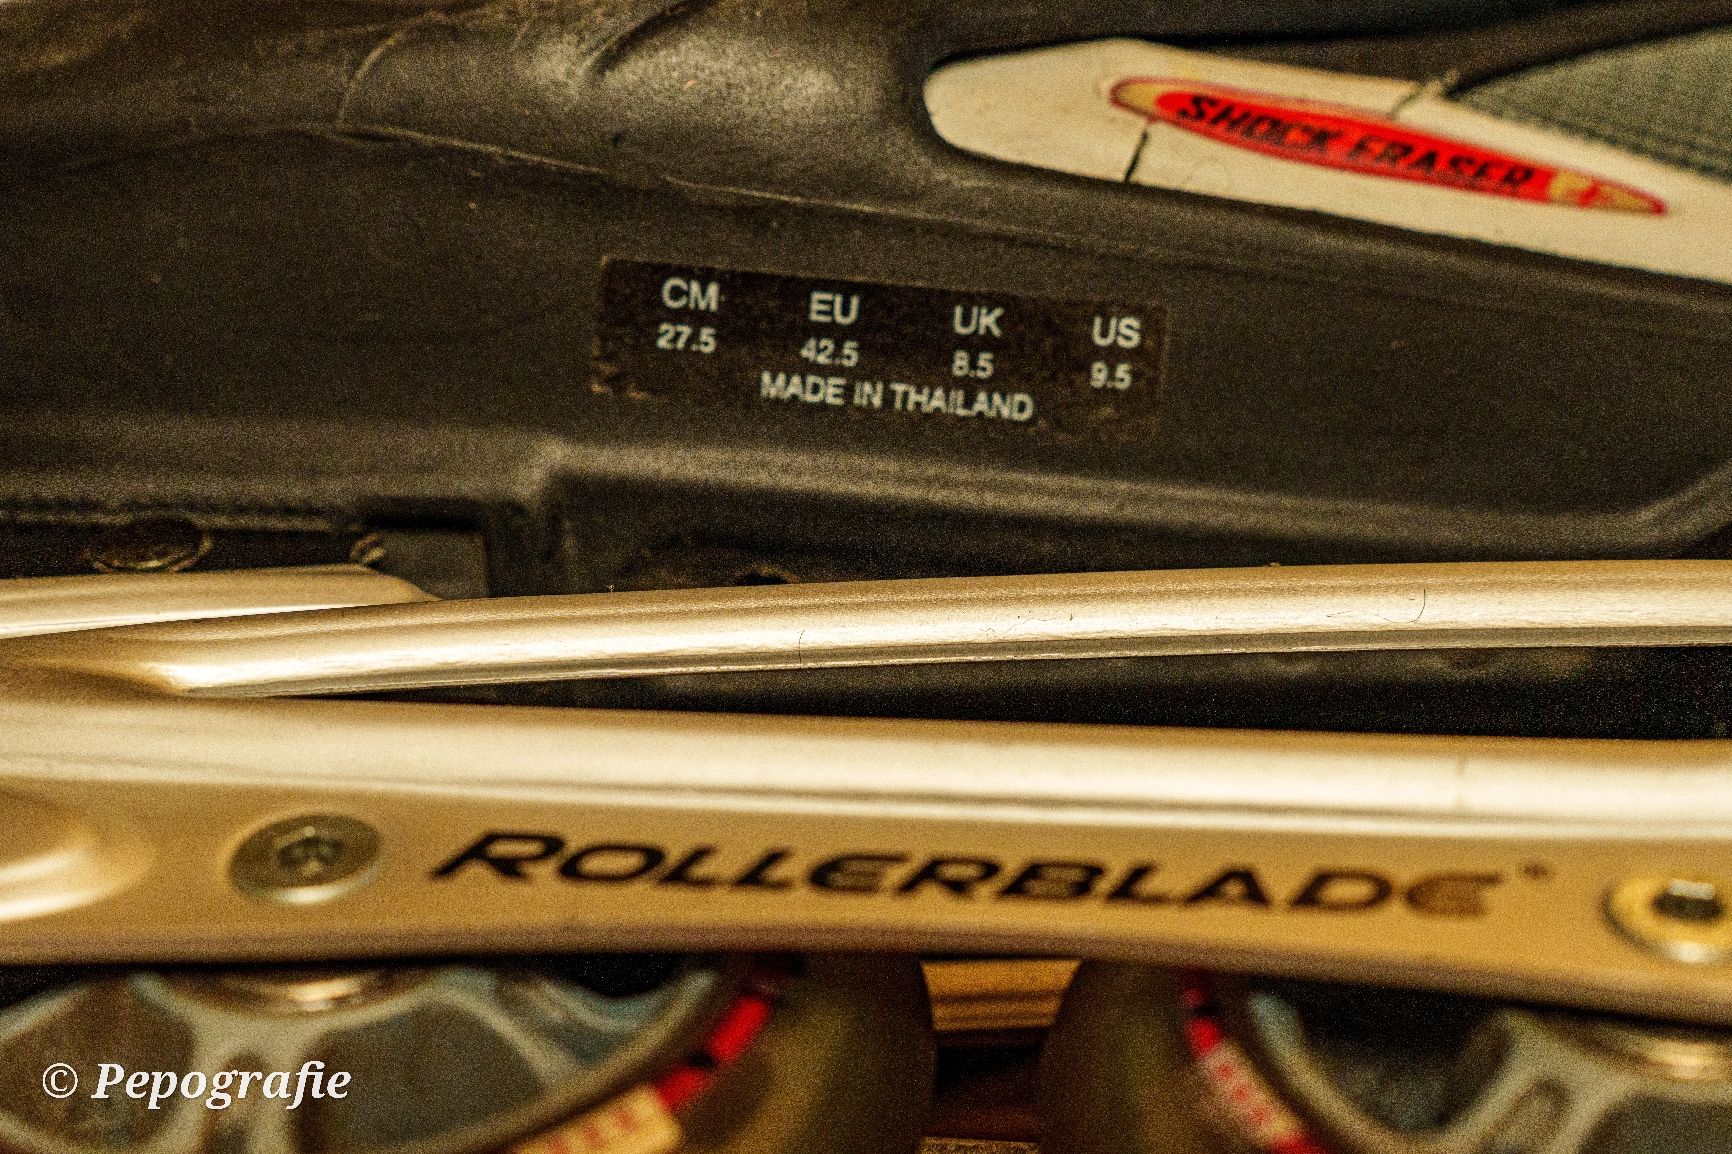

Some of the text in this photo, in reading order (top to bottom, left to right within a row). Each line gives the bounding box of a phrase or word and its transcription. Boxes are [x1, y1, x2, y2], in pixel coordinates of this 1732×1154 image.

[1176, 94, 1535, 190] SHOCK ERASER
[660, 278, 1141, 349] CM EU UK US
[656, 322, 1134, 391] 27.5 42.5 8.5 9.5
[760, 371, 1035, 423] MADE IN THAILAND
[430, 830, 1504, 918] ROLLERBLADE
